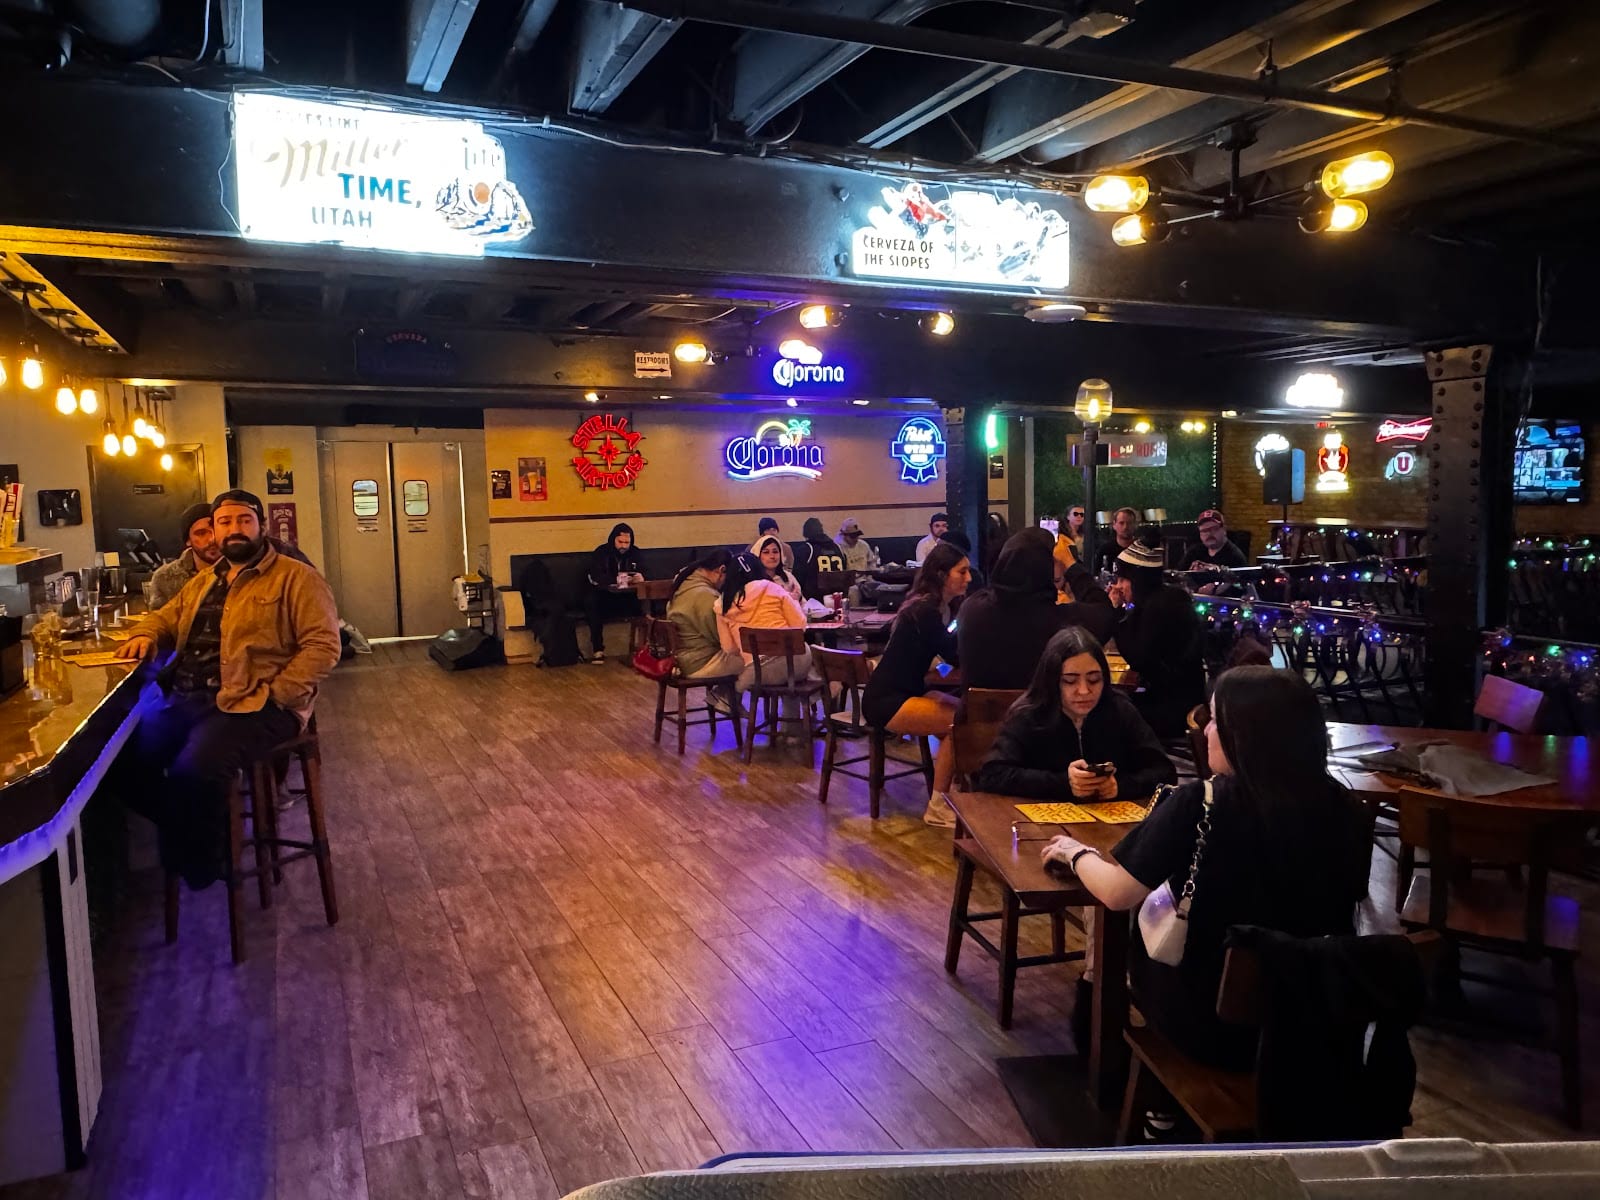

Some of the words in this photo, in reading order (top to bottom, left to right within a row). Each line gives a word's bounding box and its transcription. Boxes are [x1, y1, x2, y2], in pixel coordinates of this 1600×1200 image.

[337, 172, 422, 208] TIME,
[311, 206, 373, 229] UTAH
[863, 234, 915, 252] CERVEZA
[920, 240, 935, 254] OF
[864, 253, 884, 266] THE
[889, 255, 931, 270] SLOPES
[772, 359, 845, 388] Corona
[573, 414, 643, 450] STELLA
[726, 437, 825, 472] Corona
[1397, 456, 1411, 472] U
[573, 454, 645, 491] ARTOIS
